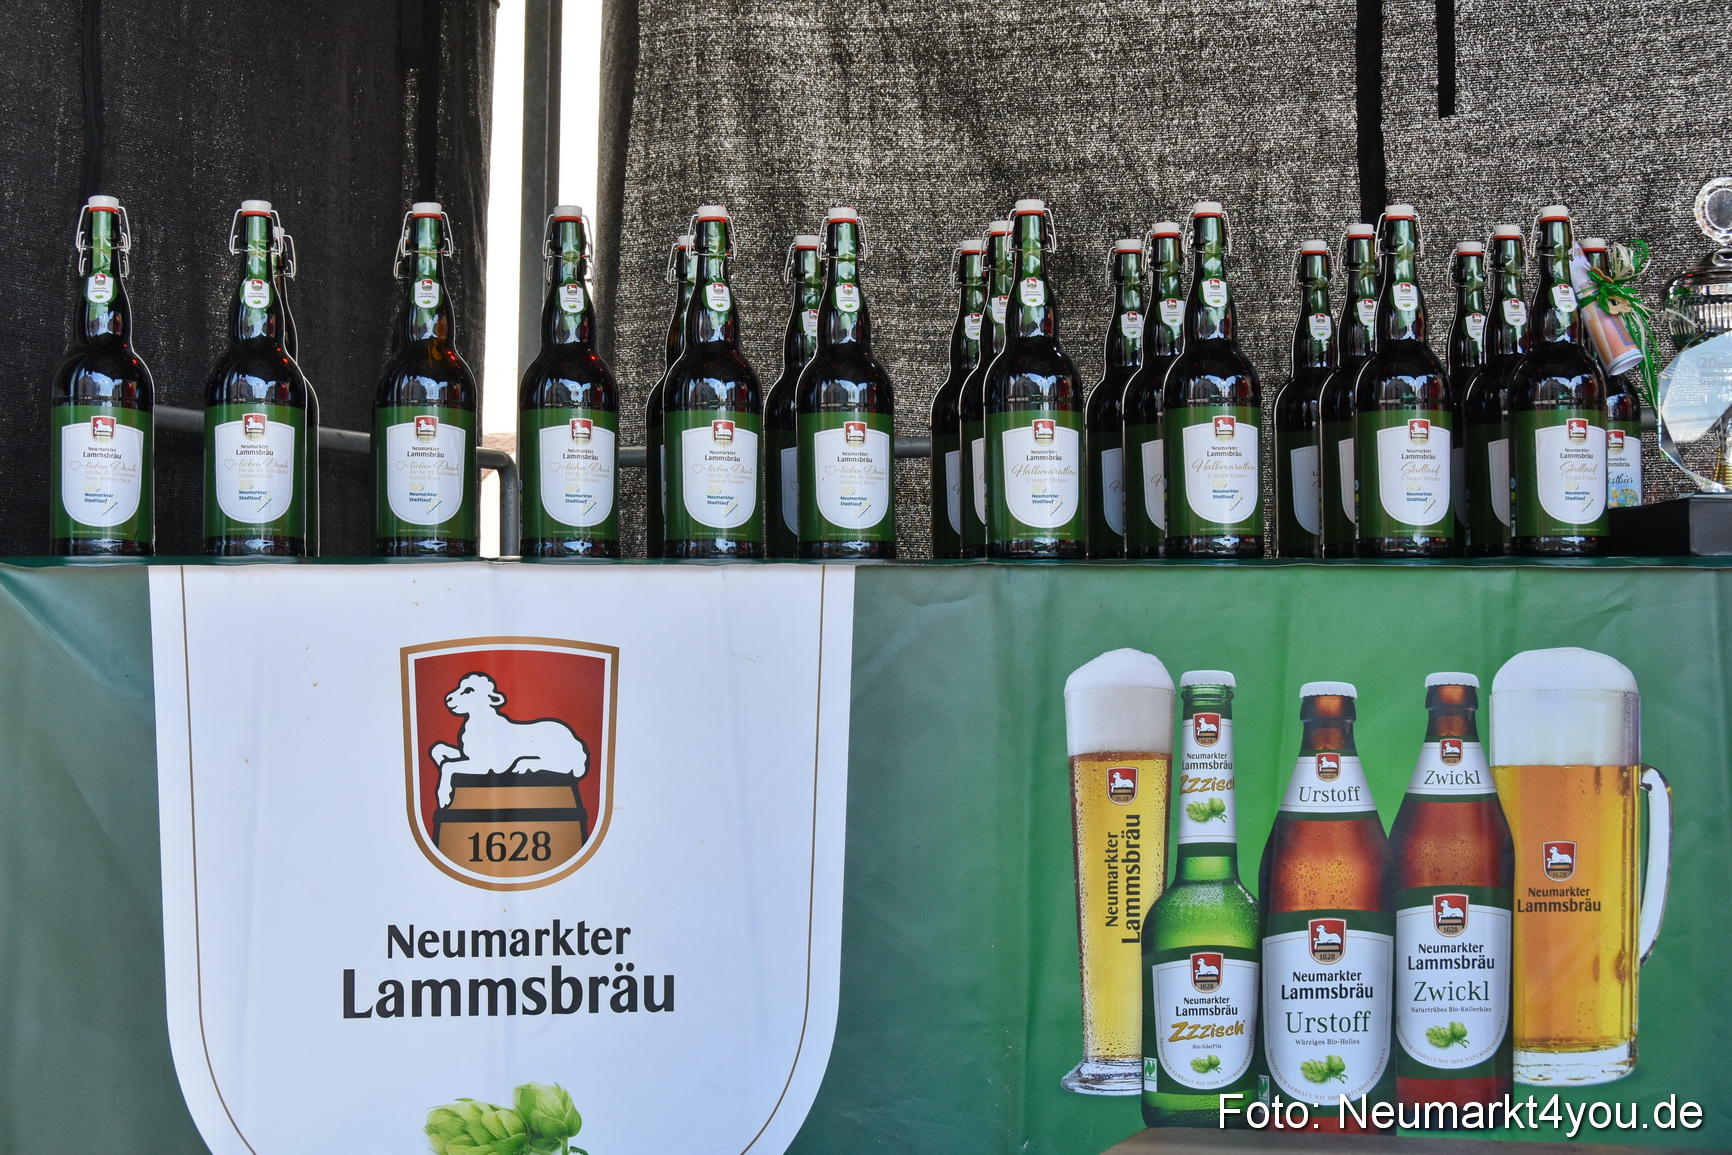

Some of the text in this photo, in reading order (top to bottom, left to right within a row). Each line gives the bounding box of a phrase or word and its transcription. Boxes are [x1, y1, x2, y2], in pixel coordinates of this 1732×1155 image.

[83, 451, 121, 459] Lammsbräu
[1012, 464, 1077, 477] Halbmarathon
[1192, 459, 1256, 472] Halbmarathon
[1401, 461, 1441, 477] Stadtlauf
[1560, 461, 1598, 475] Stadtlauf
[1182, 760, 1233, 770] Lammsbräu
[1424, 770, 1481, 785] Zwickl
[1299, 786, 1360, 802] Urstoff
[468, 831, 552, 862] 1628
[1104, 832, 1119, 927] Neumarkter
[1121, 814, 1140, 943] Lammsbräu
[1528, 887, 1591, 897] Neumarkter
[1517, 898, 1601, 912] Lammsbräu
[387, 919, 632, 959] Neumarkter
[1418, 942, 1484, 953] Neumarkter
[1408, 955, 1495, 970] Lammsbräu
[1292, 970, 1362, 982] Neumarkter
[343, 962, 675, 1019] Lammsbräu
[1281, 983, 1373, 1000] Lammsbräu
[1413, 981, 1490, 1001] Zwickl
[1184, 996, 1230, 1004] Neumarkter
[1176, 1005, 1238, 1017] Lammsbräu
[1285, 1011, 1372, 1034] Urstoff
[1295, 1038, 1325, 1046] Würziges
